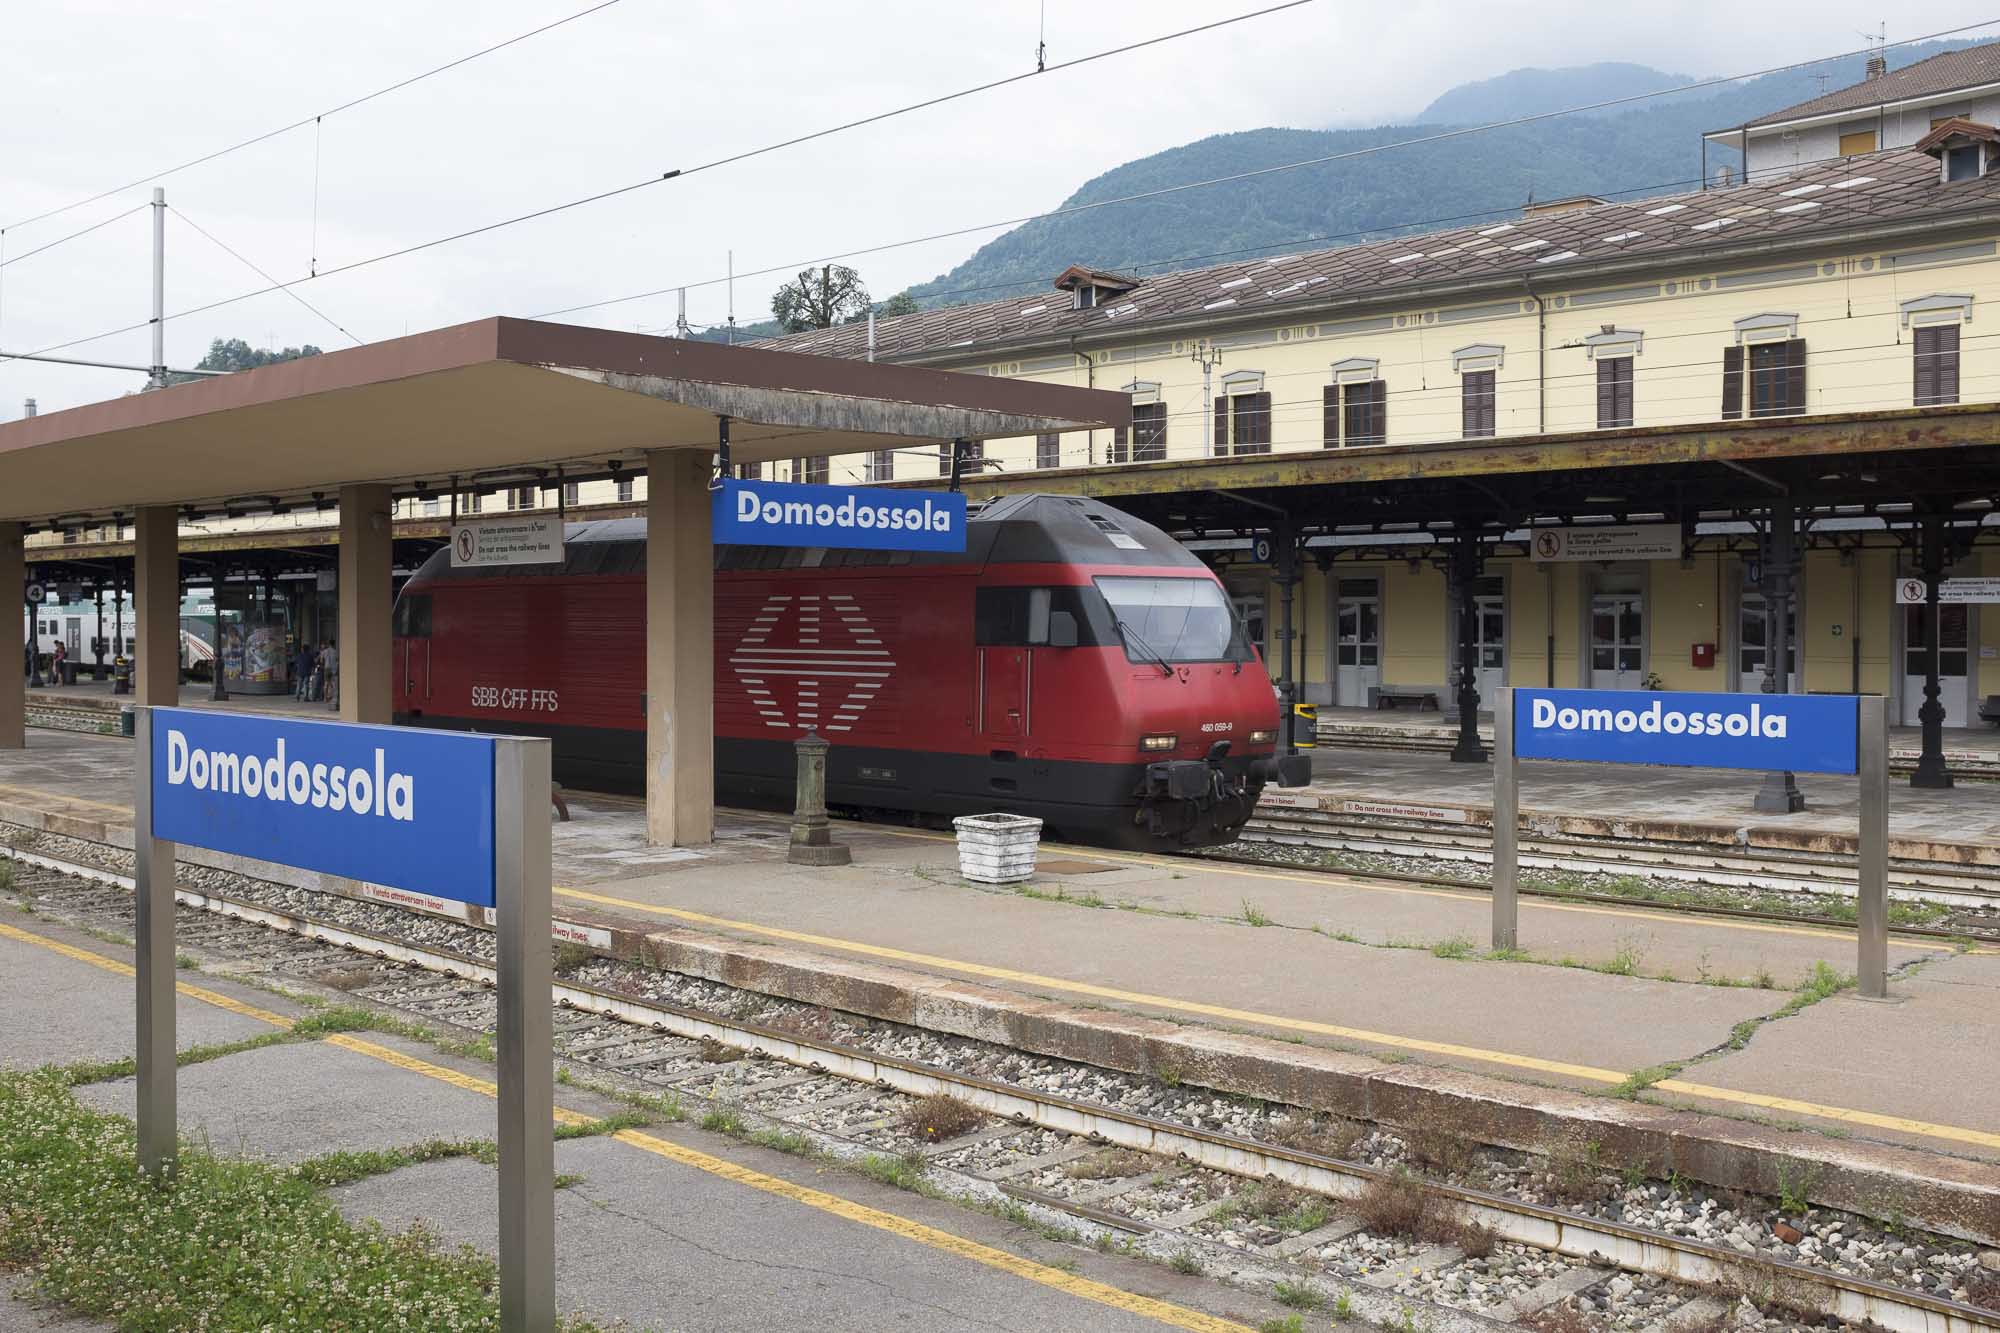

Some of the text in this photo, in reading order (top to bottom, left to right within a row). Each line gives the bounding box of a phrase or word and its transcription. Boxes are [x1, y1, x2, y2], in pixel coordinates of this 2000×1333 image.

[738, 491, 950, 532] Domodossola
[478, 545, 485, 553] Do
[509, 543, 517, 552] the
[518, 543, 536, 553] railway
[472, 686, 558, 711] SBB CFF FFS
[1533, 699, 1787, 738] Domodossola
[168, 730, 414, 821] Domodossola
[1354, 803, 1363, 812] Do
[1364, 804, 1375, 812] not
[1404, 808, 1428, 817] railway
[1429, 810, 1444, 818] lines
[372, 886, 390, 898] Vietato
[391, 892, 424, 906] attraversare
[427, 898, 445, 911] binari
[552, 924, 588, 941] ilway lines
